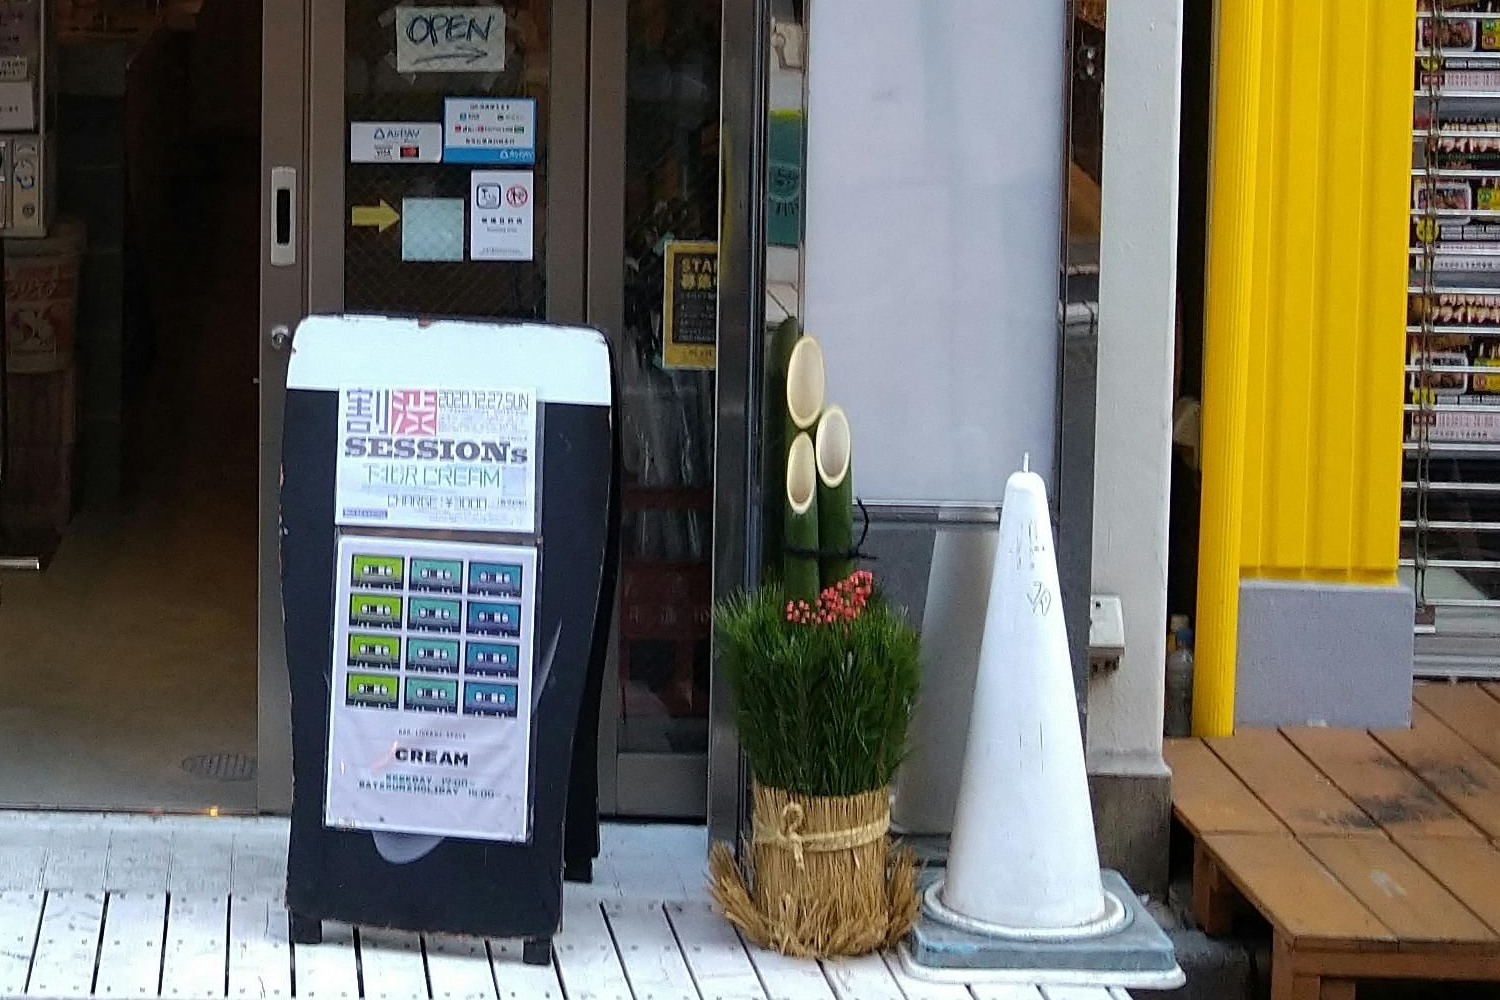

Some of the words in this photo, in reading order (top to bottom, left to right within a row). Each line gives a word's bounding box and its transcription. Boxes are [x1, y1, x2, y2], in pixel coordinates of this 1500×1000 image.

[406, 13, 494, 47] OPEN
[423, 465, 500, 489] CREAM
[395, 747, 469, 768] CREAM
[385, 773, 433, 785] WEEKDAY
